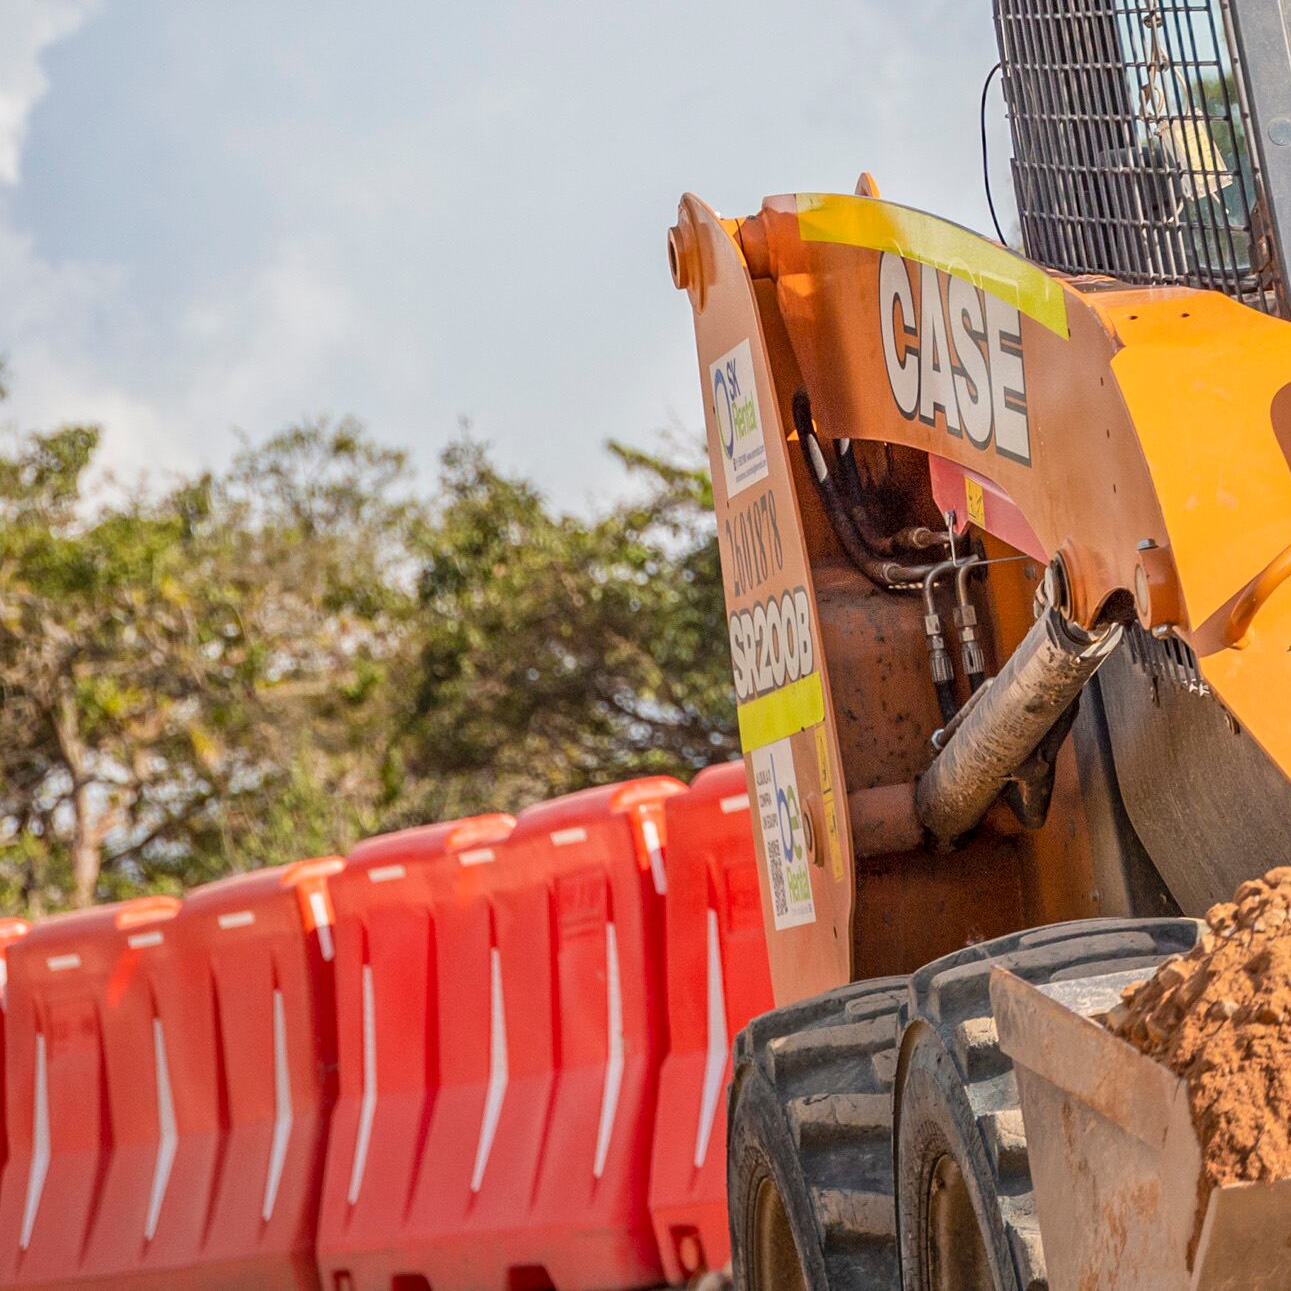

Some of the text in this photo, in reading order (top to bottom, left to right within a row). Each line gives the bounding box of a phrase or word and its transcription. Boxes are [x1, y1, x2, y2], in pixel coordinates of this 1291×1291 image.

[879, 251, 1031, 467] CASE
[732, 391, 757, 441] Rental
[726, 490, 783, 597] 2601878
[729, 585, 814, 704] SR200B
